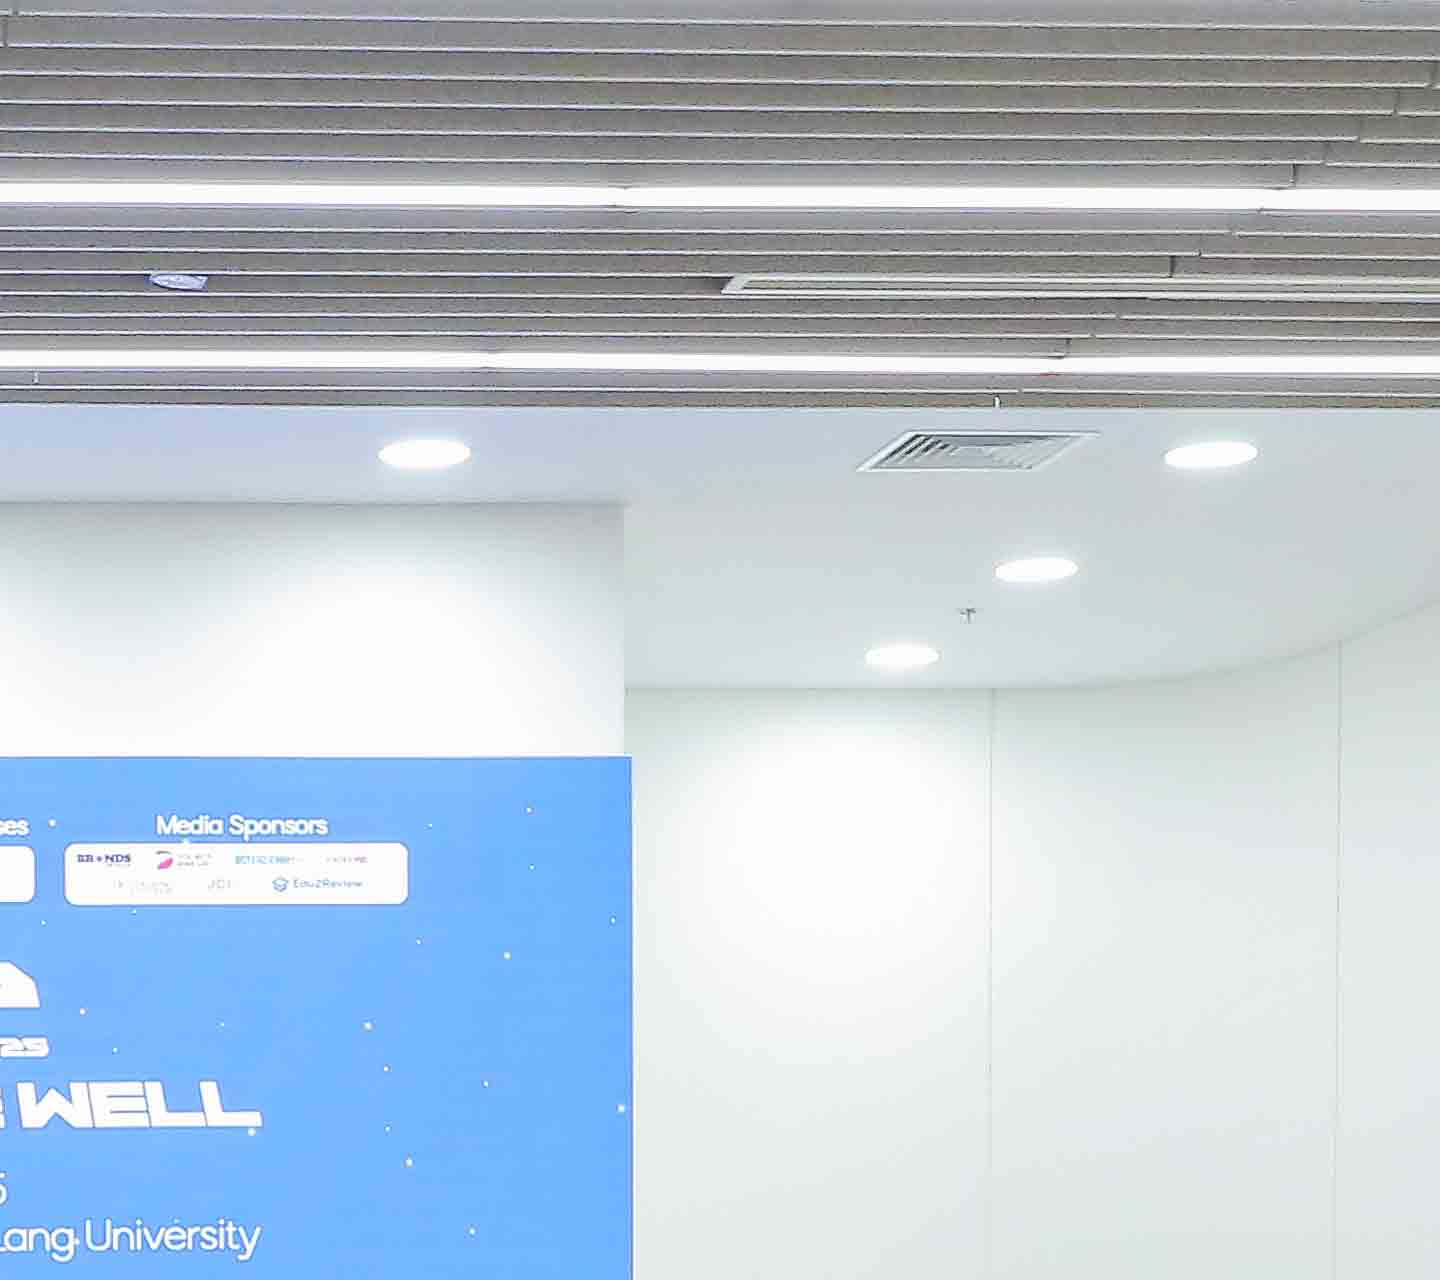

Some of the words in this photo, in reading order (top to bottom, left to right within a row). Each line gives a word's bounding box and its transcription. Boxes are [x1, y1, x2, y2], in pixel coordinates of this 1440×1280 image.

[155, 814, 224, 836] Media
[228, 813, 329, 842] Sponsors
[17, 1081, 264, 1129] WELL
[84, 1218, 263, 1262] University
